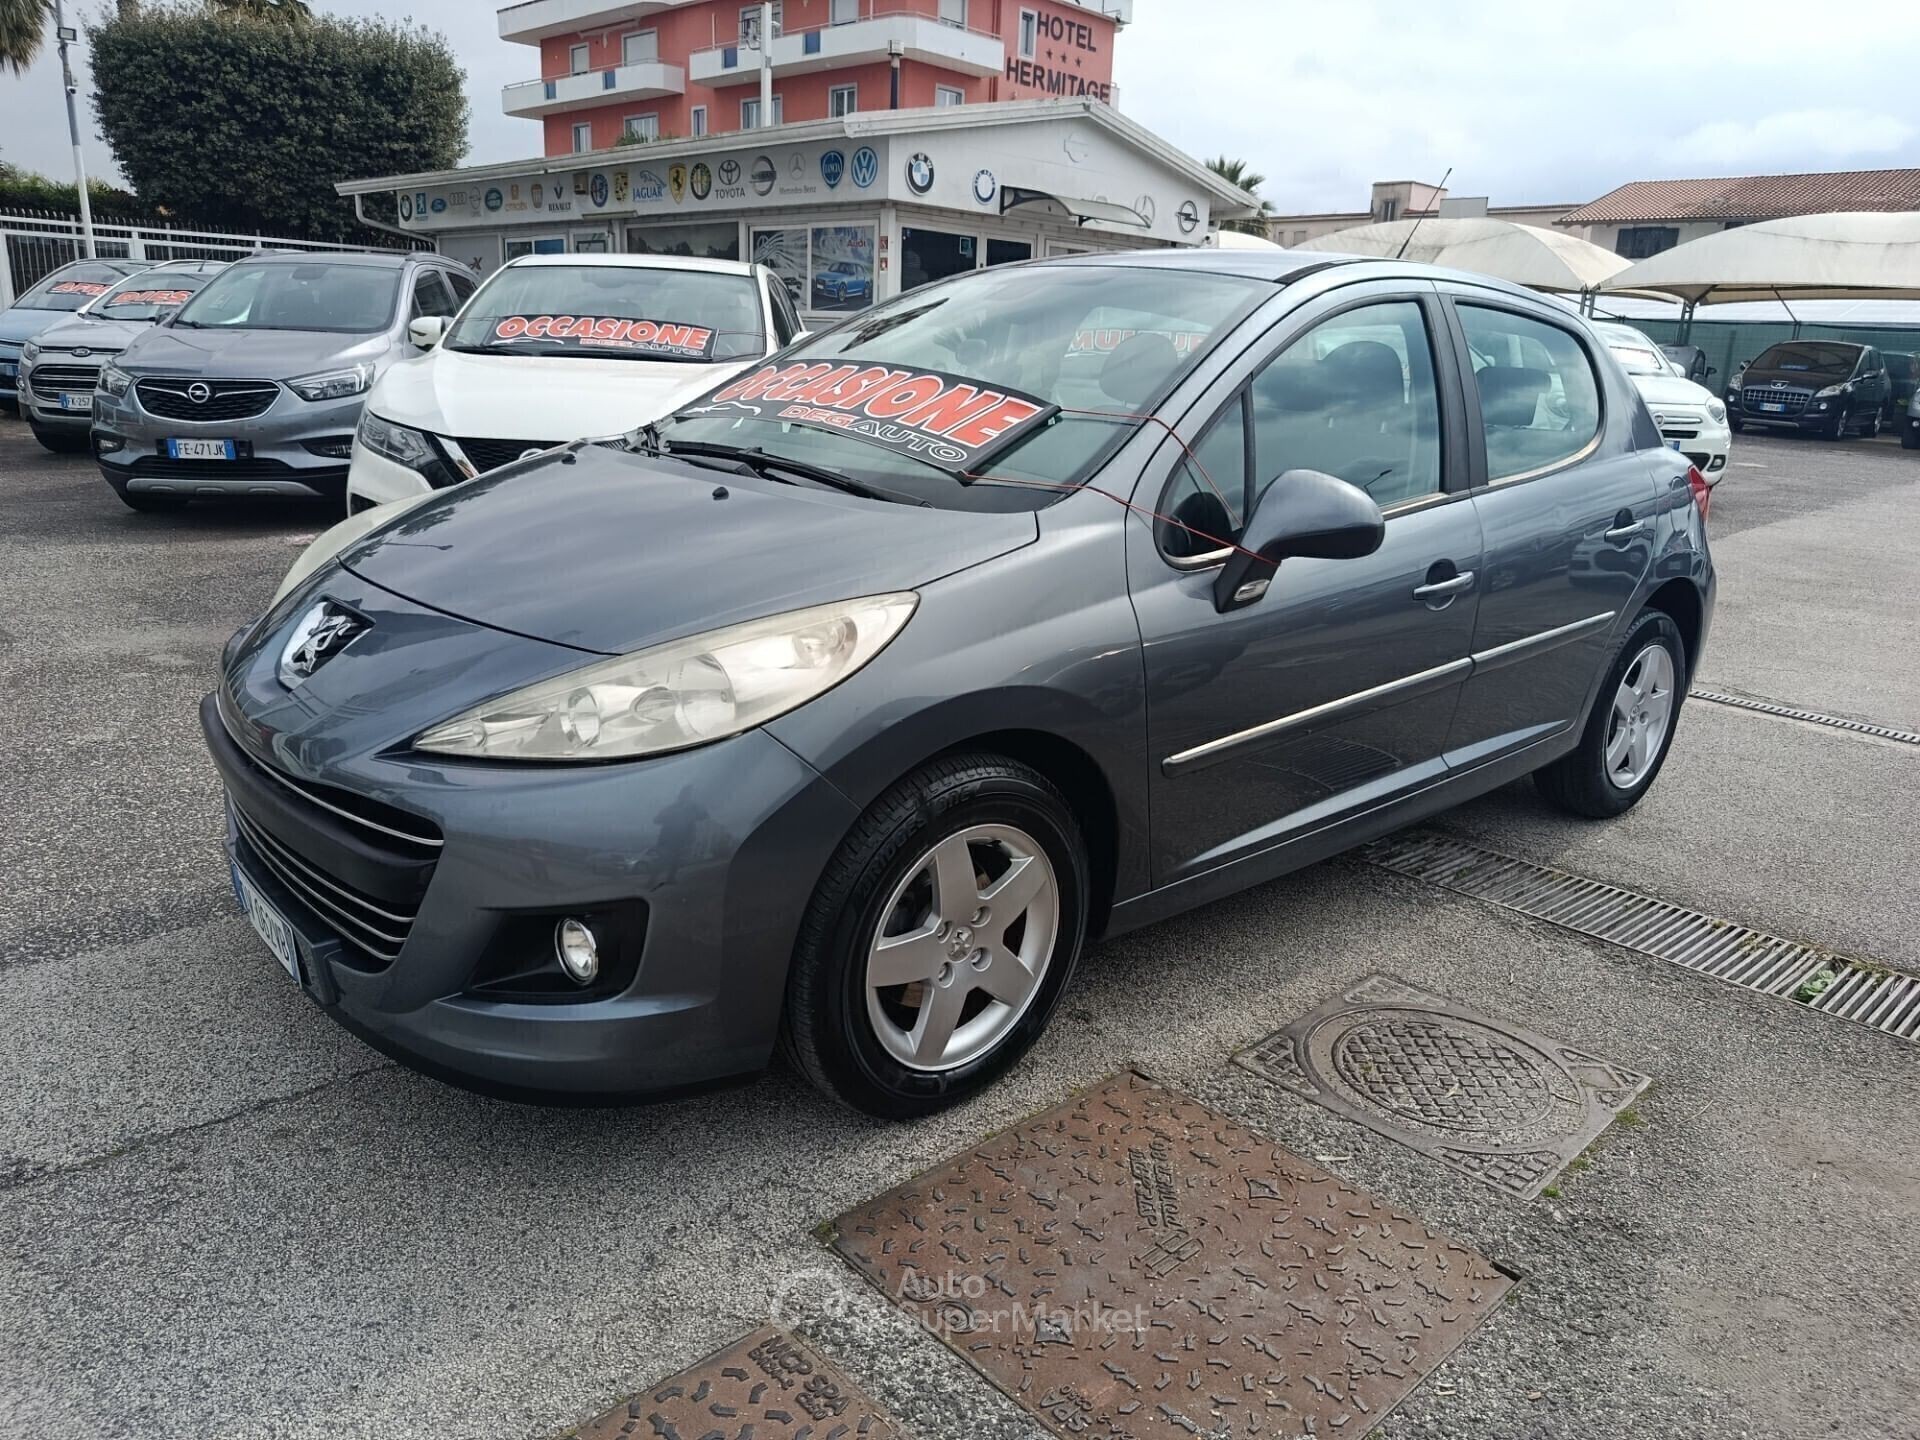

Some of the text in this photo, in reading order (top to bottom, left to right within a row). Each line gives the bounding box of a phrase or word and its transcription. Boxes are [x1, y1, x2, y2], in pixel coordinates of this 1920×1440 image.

[1037, 11, 1097, 53] HOTEL
[1006, 56, 1111, 106] HERMITAGE
[633, 186, 663, 202] JAGUAR
[715, 187, 746, 200] TOYOTA
[496, 315, 713, 350] OCCASIONE
[711, 362, 1044, 449] OCCASIONE
[803, 1375, 850, 1416] SPA
[1039, 1385, 1093, 1433] SPA
